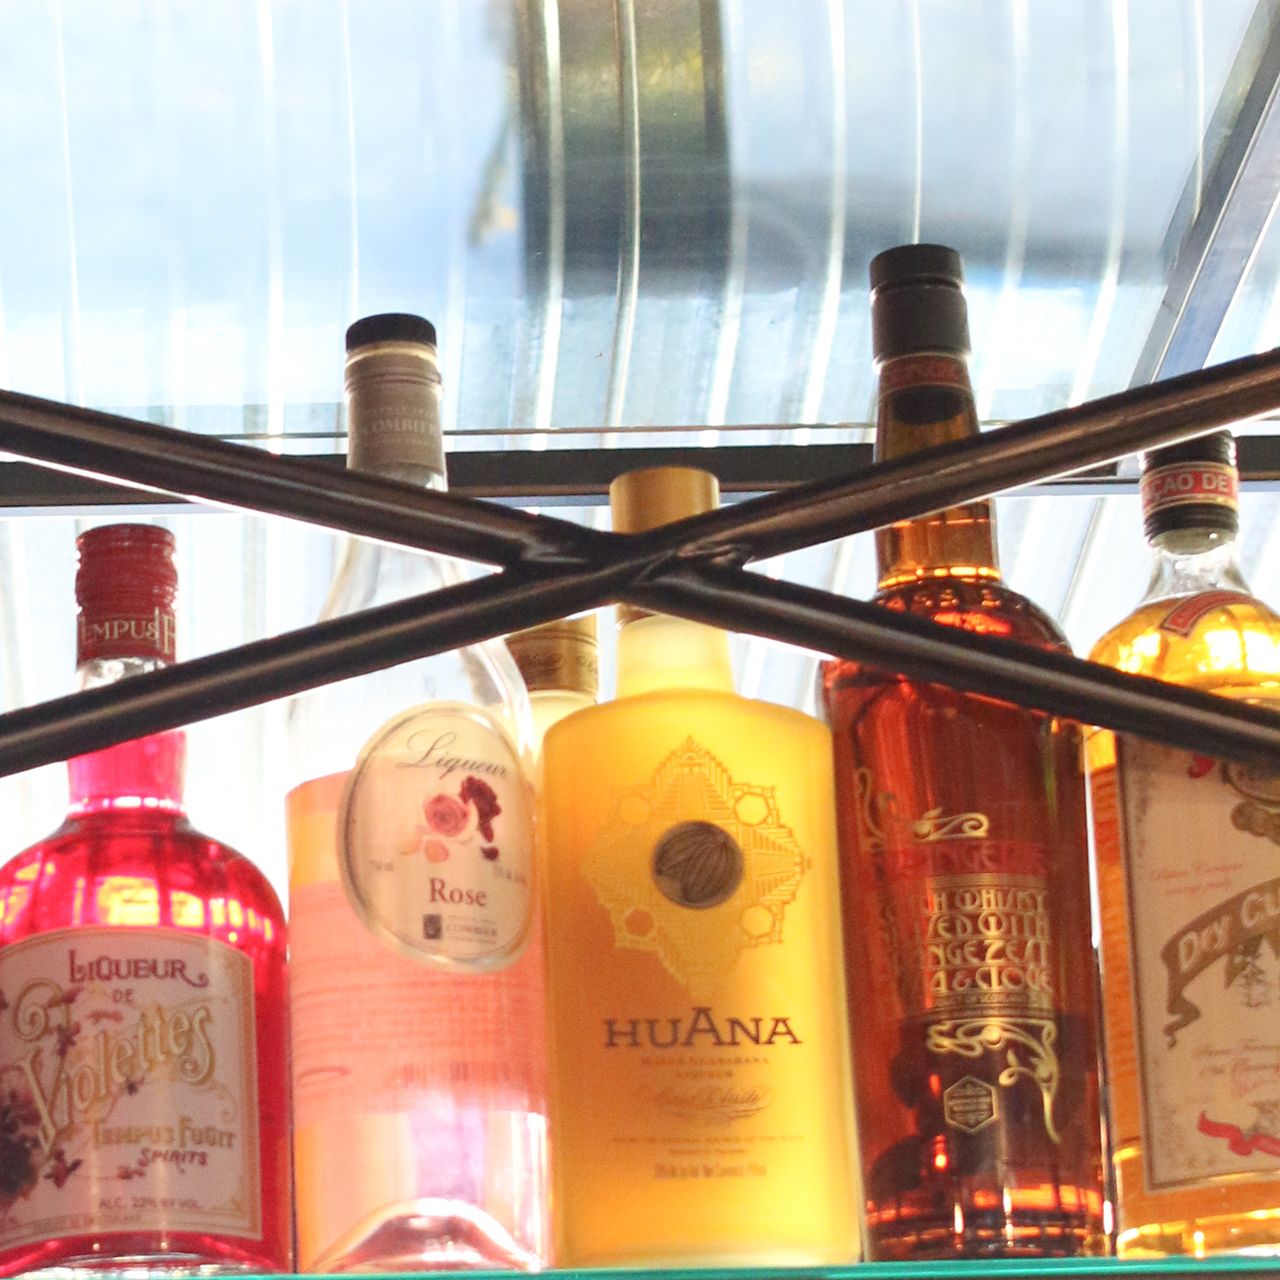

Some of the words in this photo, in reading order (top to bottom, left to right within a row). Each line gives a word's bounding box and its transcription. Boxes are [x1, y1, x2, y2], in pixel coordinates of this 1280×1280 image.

[396, 729, 507, 780] Liqueur
[429, 877, 488, 907] Rose
[69, 949, 210, 989] LIQUEUR
[111, 988, 133, 1004] DE
[604, 1006, 803, 1049] HUANA
[139, 1147, 209, 1170] SPIRITS
